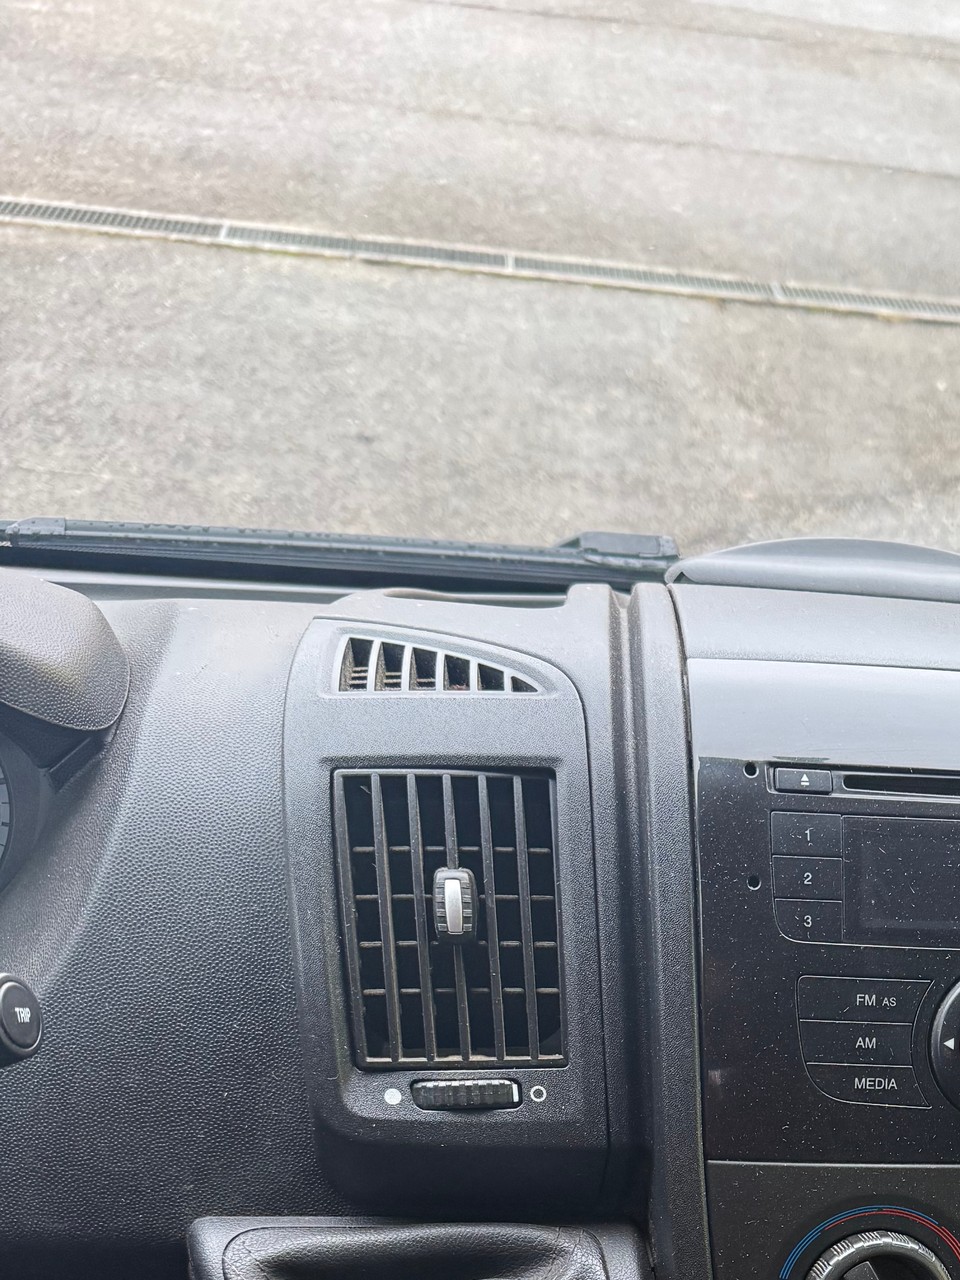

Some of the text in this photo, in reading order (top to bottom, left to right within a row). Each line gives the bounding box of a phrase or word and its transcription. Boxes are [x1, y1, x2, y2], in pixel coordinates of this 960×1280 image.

[804, 828, 811, 841] 1
[803, 872, 812, 885] 2
[803, 915, 812, 928] 3
[856, 994, 897, 1007] FM AS
[14, 1007, 31, 1023] TRIP
[855, 1037, 876, 1049] AM
[854, 1078, 898, 1090] MEDIA
